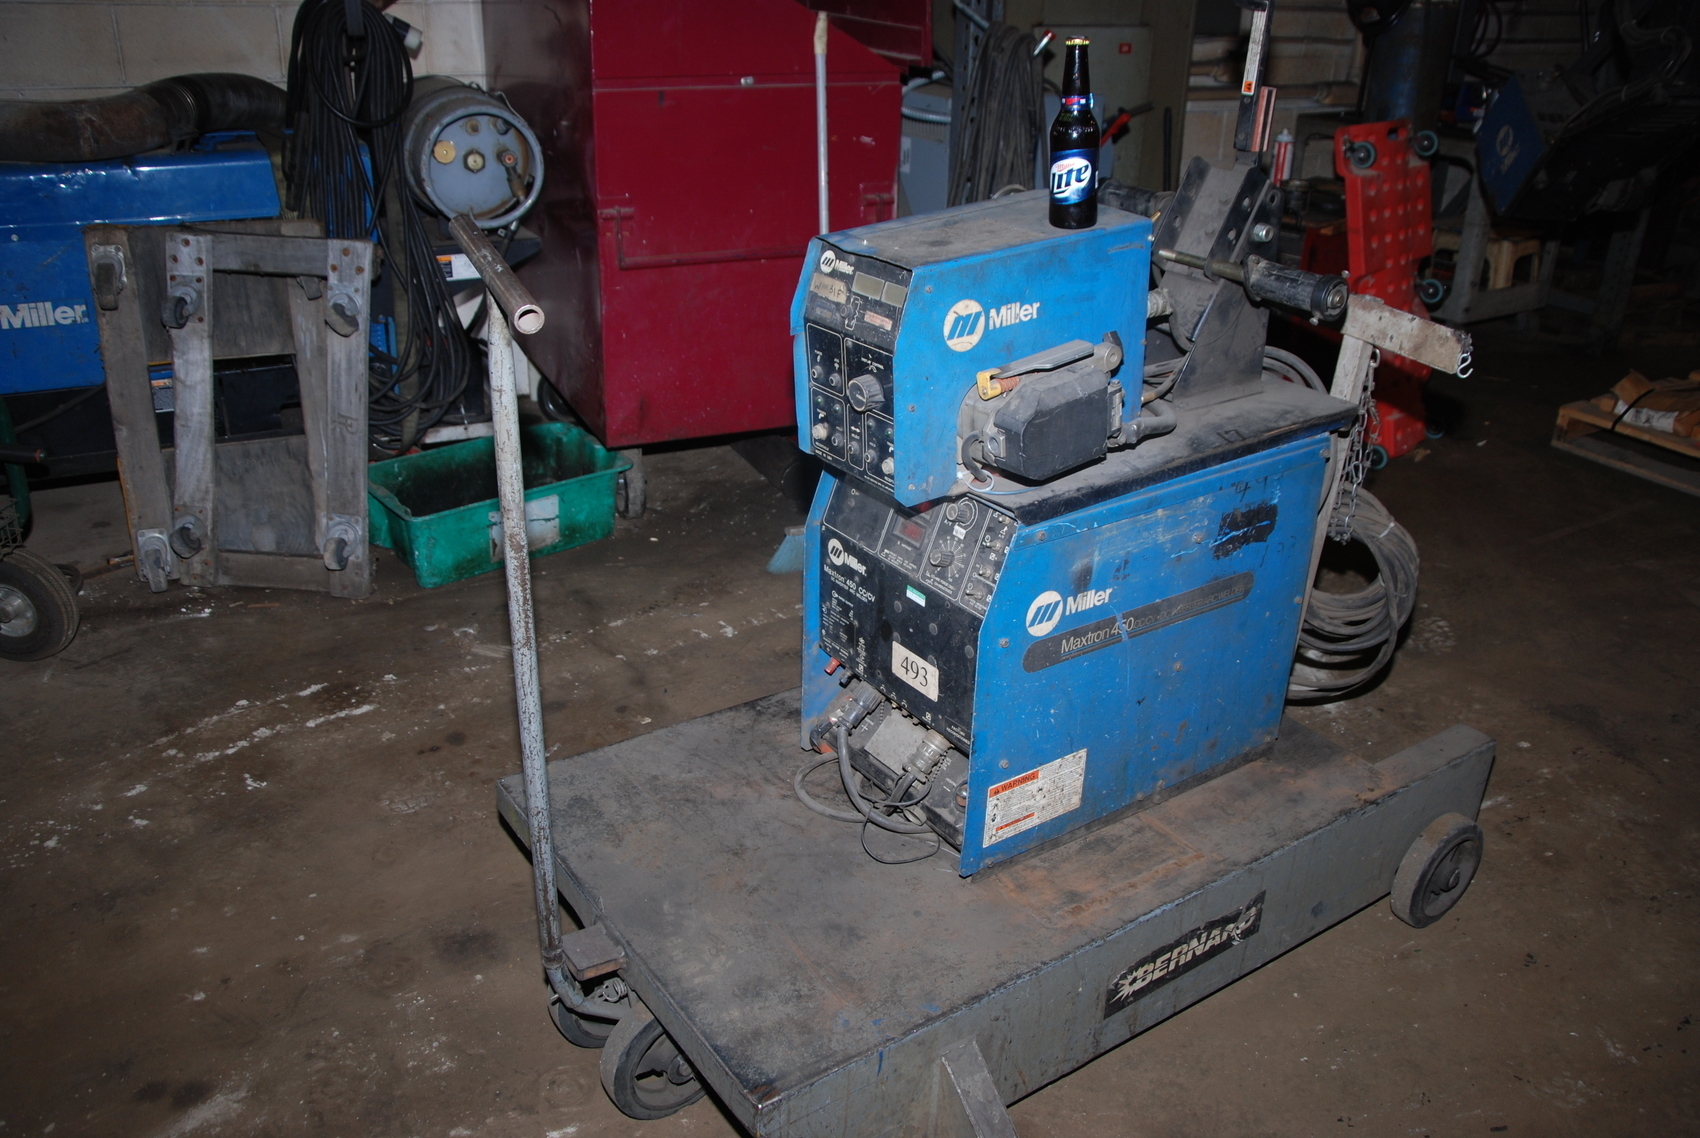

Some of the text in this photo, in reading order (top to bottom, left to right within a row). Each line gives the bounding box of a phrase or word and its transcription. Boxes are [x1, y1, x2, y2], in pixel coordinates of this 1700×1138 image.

[1051, 164, 1090, 194] Lite
[834, 258, 854, 275] Miller
[0, 301, 87, 330] Miller
[988, 301, 1041, 331] Miller
[823, 564, 846, 583] Maxtron
[846, 577, 857, 591] 450
[844, 551, 867, 577] Miller
[1065, 587, 1114, 616] Miller
[1060, 627, 1110, 653] Maxtron
[1110, 617, 1135, 636] 450
[1203, 593, 1218, 605] ARC
[1217, 584, 1245, 600] WELDER
[900, 655, 929, 687] 493
[1001, 772, 1036, 791] WARNING
